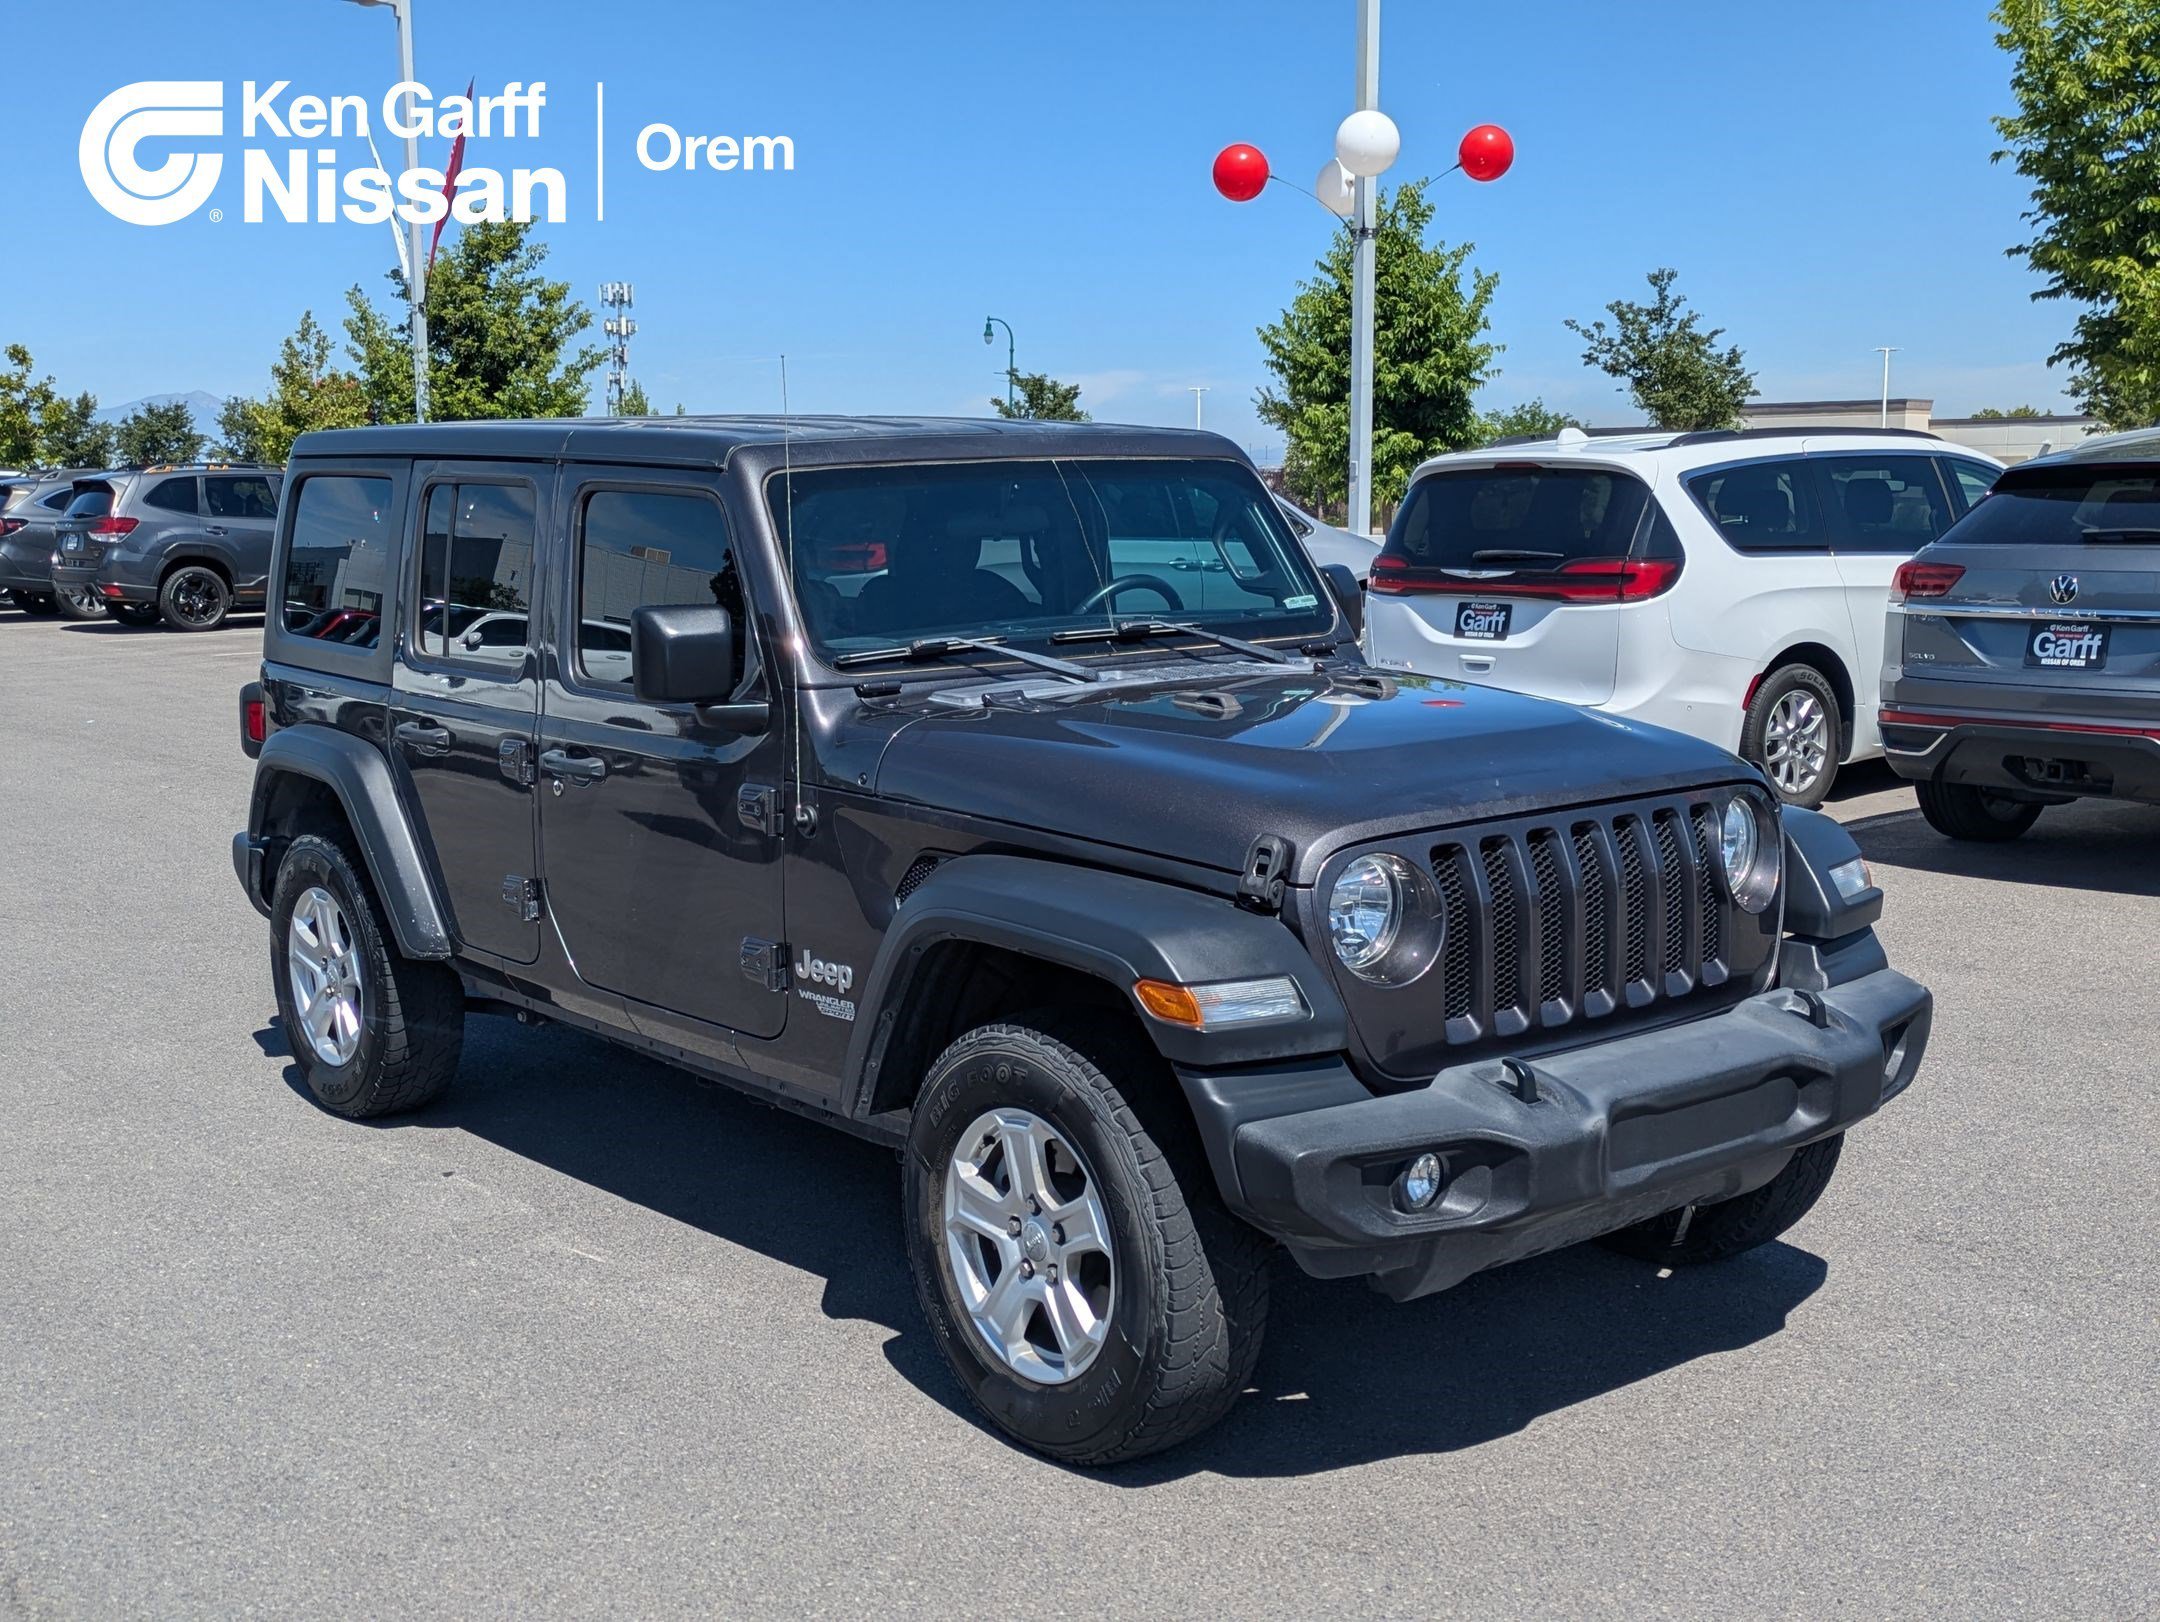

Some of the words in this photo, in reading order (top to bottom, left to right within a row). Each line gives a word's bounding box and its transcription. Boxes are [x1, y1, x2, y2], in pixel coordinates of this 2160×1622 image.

[1460, 609, 1506, 633] Garff
[2056, 624, 2070, 632] Ken
[2071, 624, 2089, 633] Garff
[2033, 631, 2103, 660] Garff
[795, 949, 853, 994] Jeep
[798, 988, 855, 1010] WRANGLER
[928, 1079, 961, 1129] BIG
[966, 1063, 1029, 1088] FOOT
